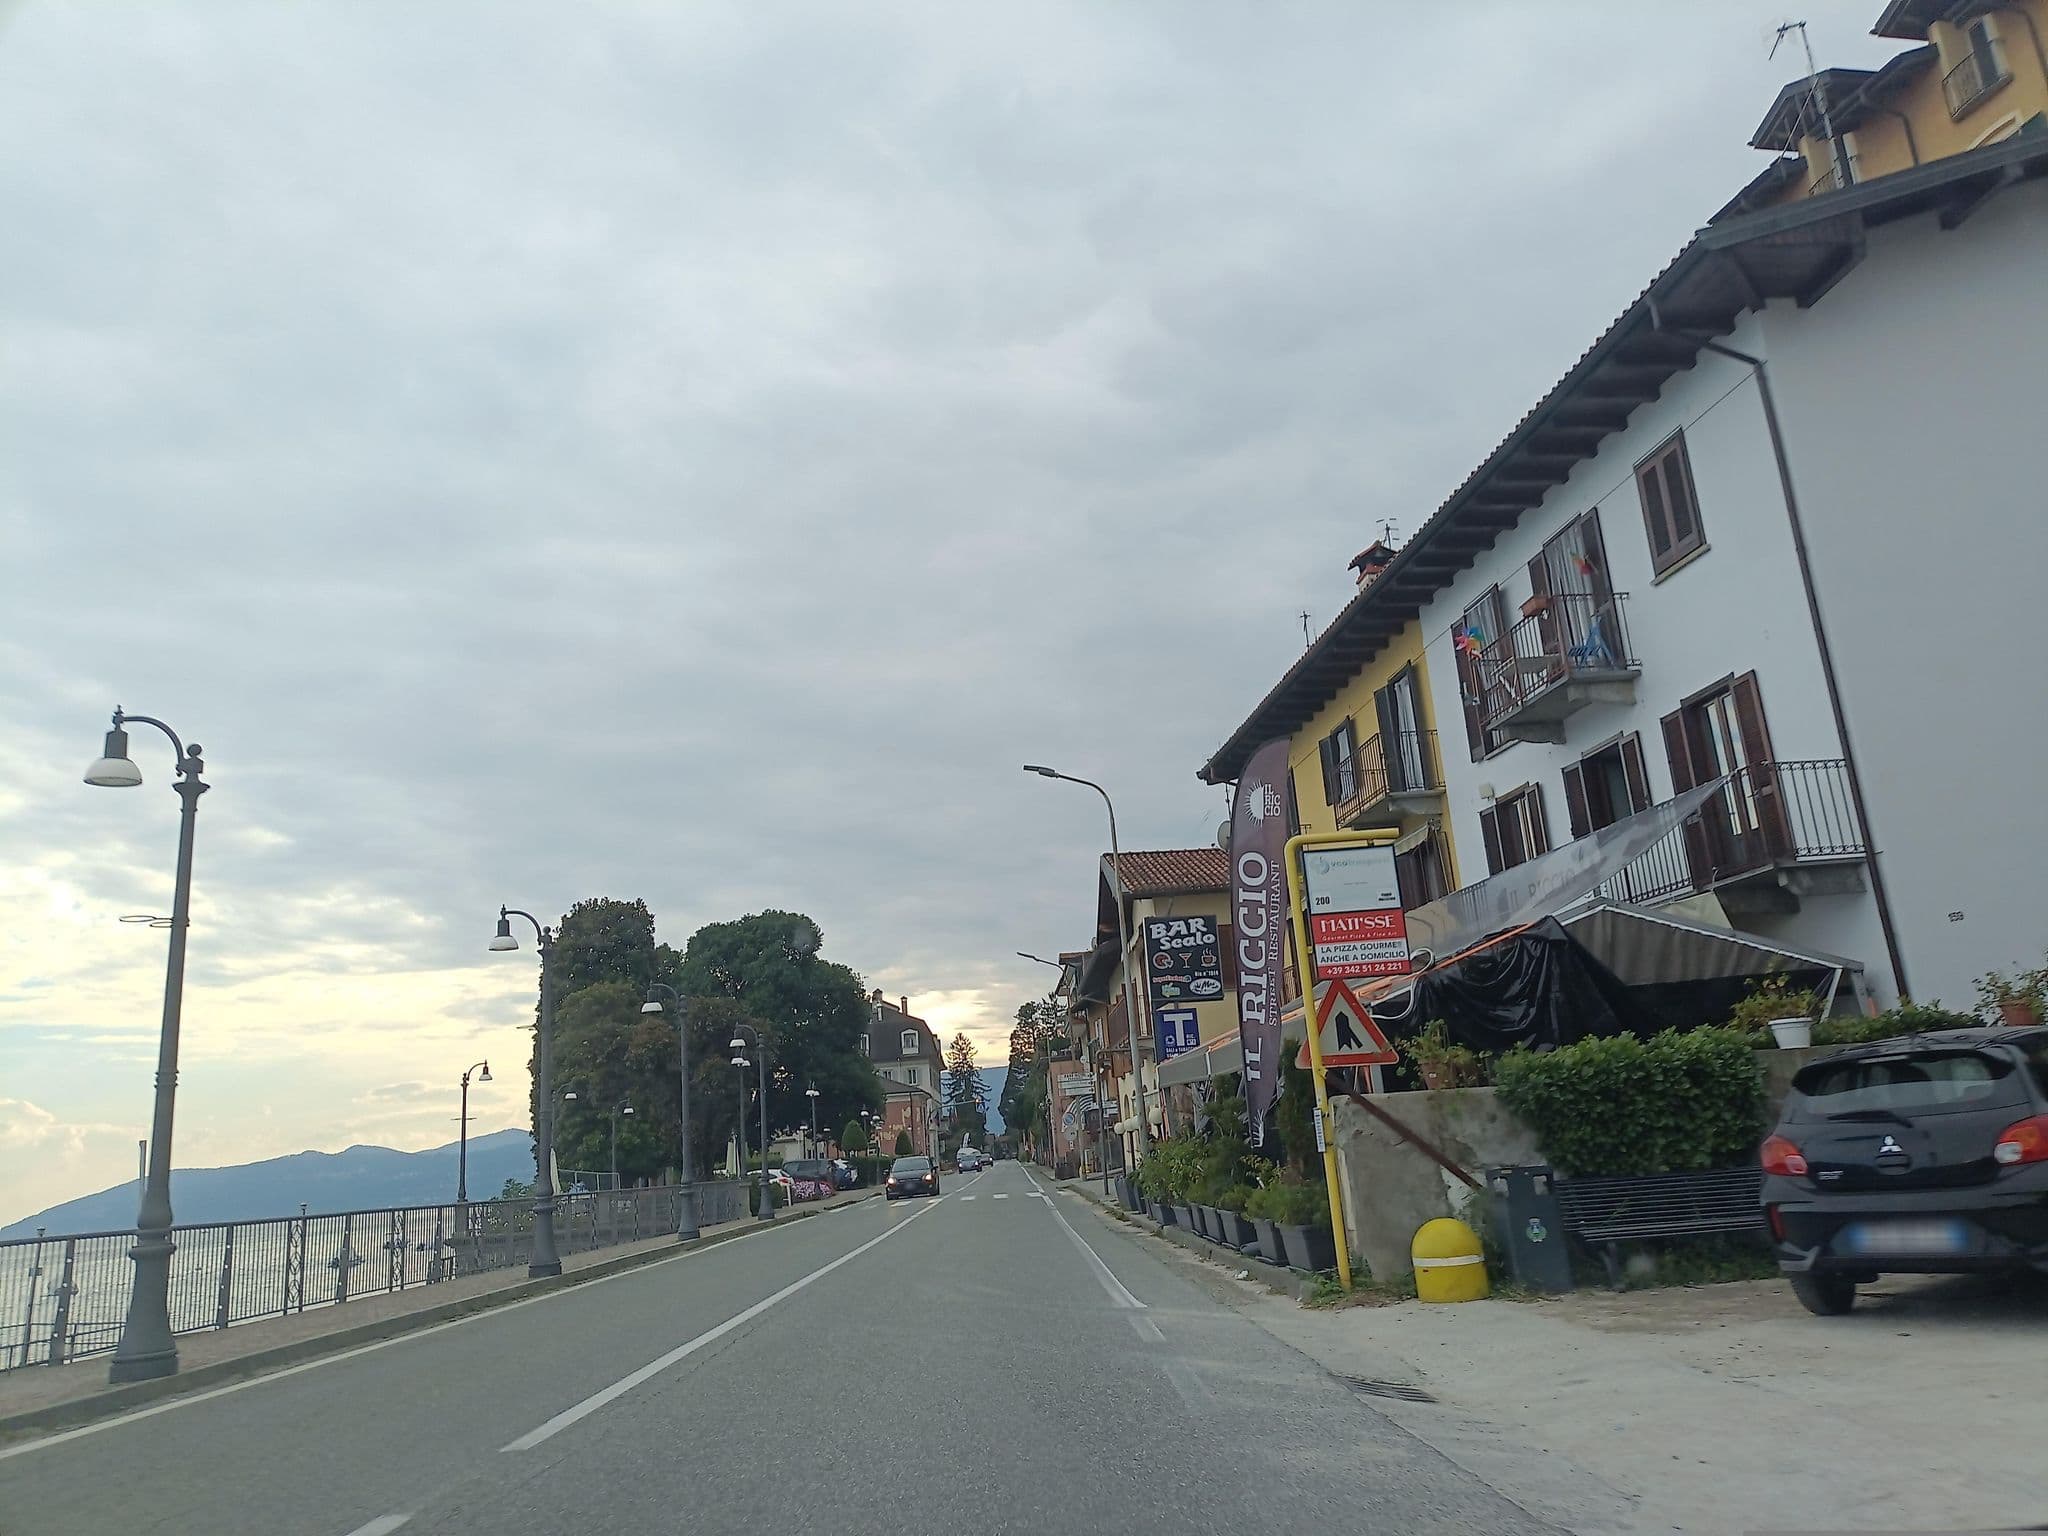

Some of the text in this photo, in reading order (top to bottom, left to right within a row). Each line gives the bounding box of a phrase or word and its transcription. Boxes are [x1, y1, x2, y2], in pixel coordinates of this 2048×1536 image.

[1264, 783, 1274, 795] IL
[1264, 794, 1281, 806] RIC
[1264, 805, 1281, 817] CIO
[1315, 896, 1331, 906] 200
[1149, 917, 1208, 939] BAR
[1159, 931, 1217, 951] Scalo
[1238, 852, 1268, 1025] RICCIO
[1267, 860, 1281, 1027] STREET RESTAURANT
[1320, 945, 1332, 954] LA
[1333, 944, 1359, 953] PIZZA
[1319, 950, 1406, 963] ANCHE A DOMICILIO
[1326, 962, 1402, 975] +39 342 51 24 221
[1163, 1012, 1194, 1047] T
